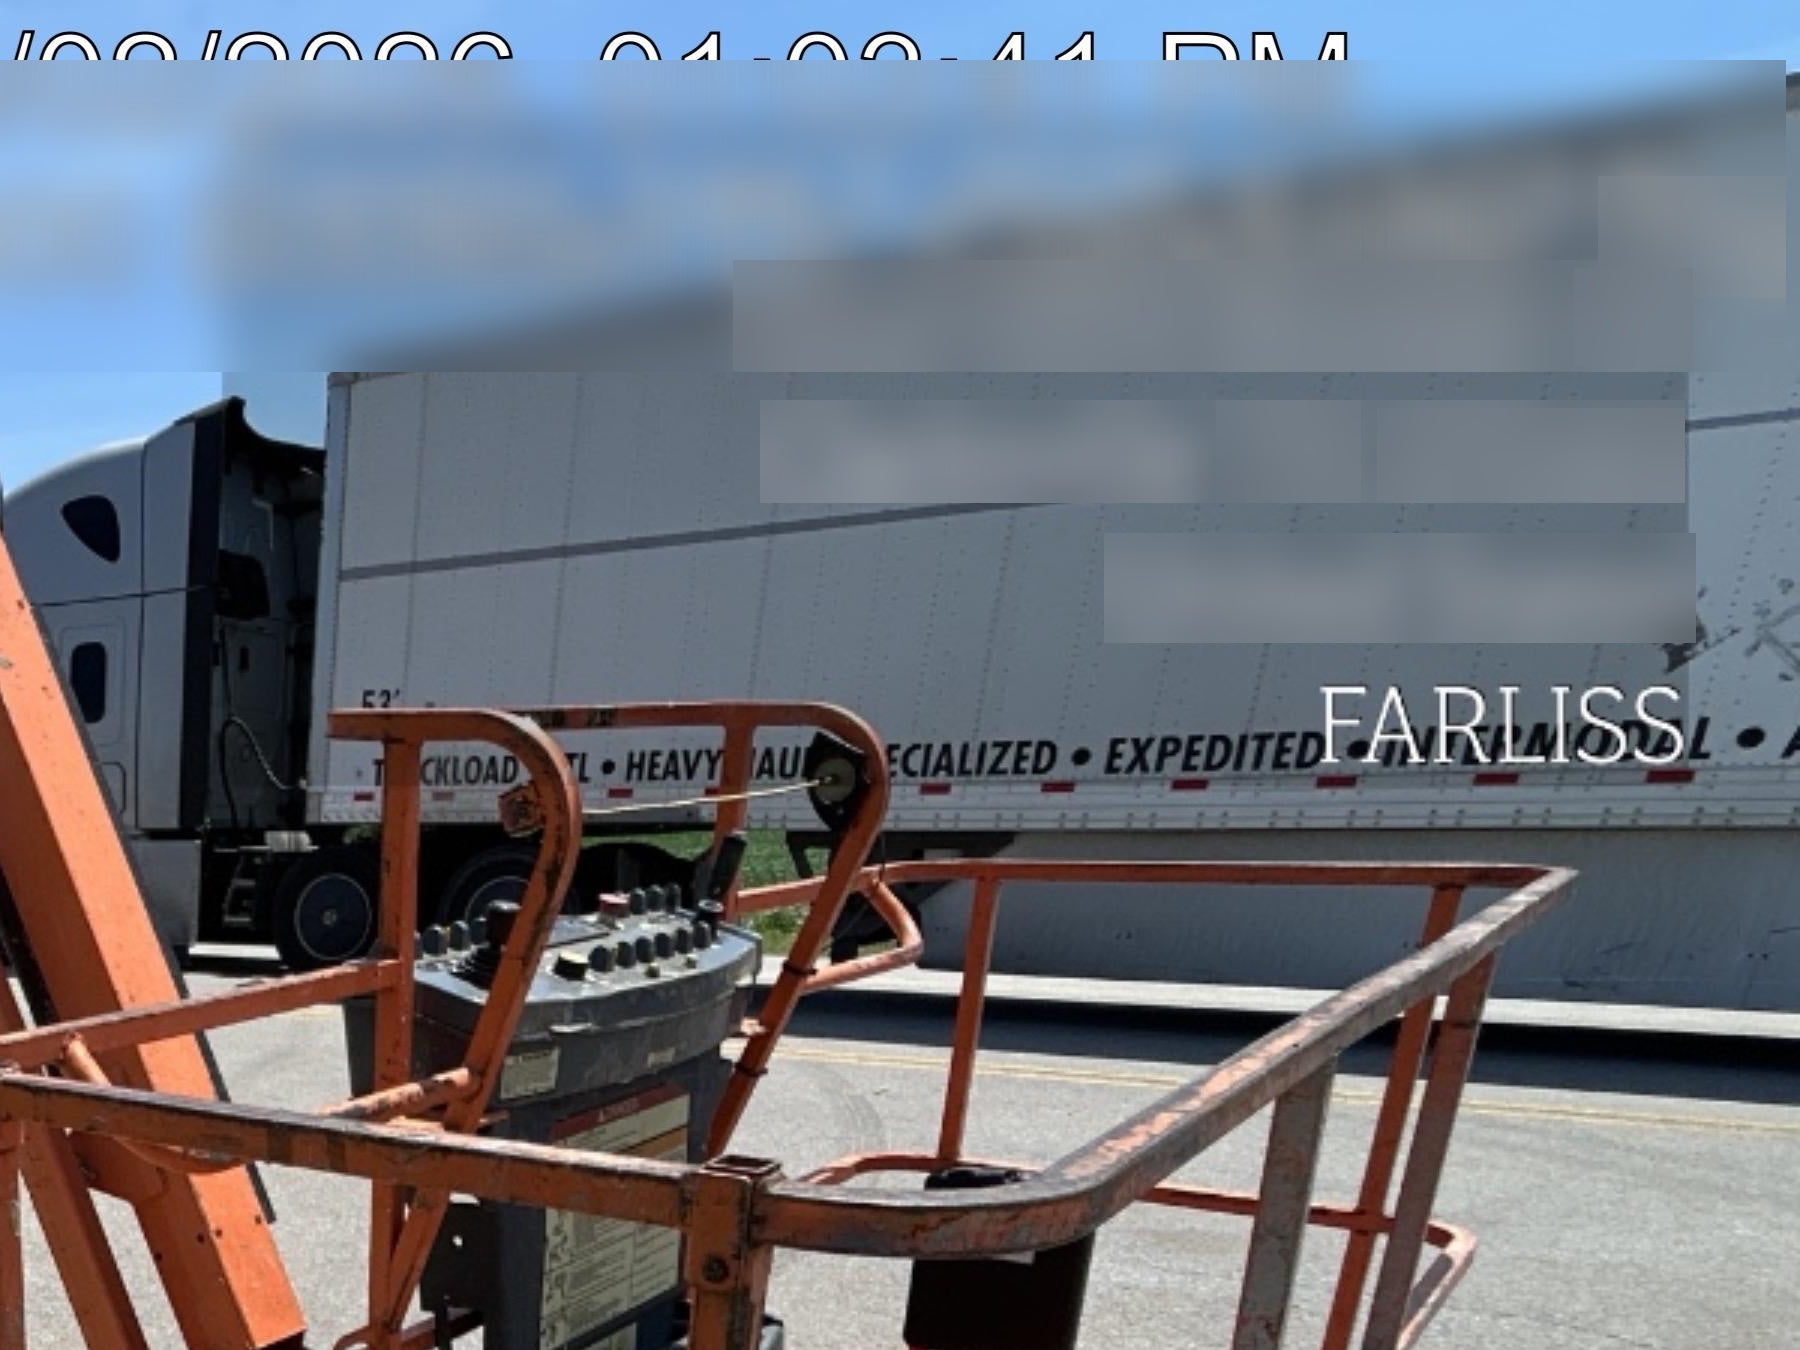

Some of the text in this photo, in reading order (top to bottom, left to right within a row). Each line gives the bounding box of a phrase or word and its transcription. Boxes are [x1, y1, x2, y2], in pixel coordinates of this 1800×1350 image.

[373, 754, 519, 787] TCKLOAD
[625, 748, 724, 782] HEAVY
[887, 739, 1058, 778] ECIALIZED
[1104, 730, 1328, 775] EXPEDITED
